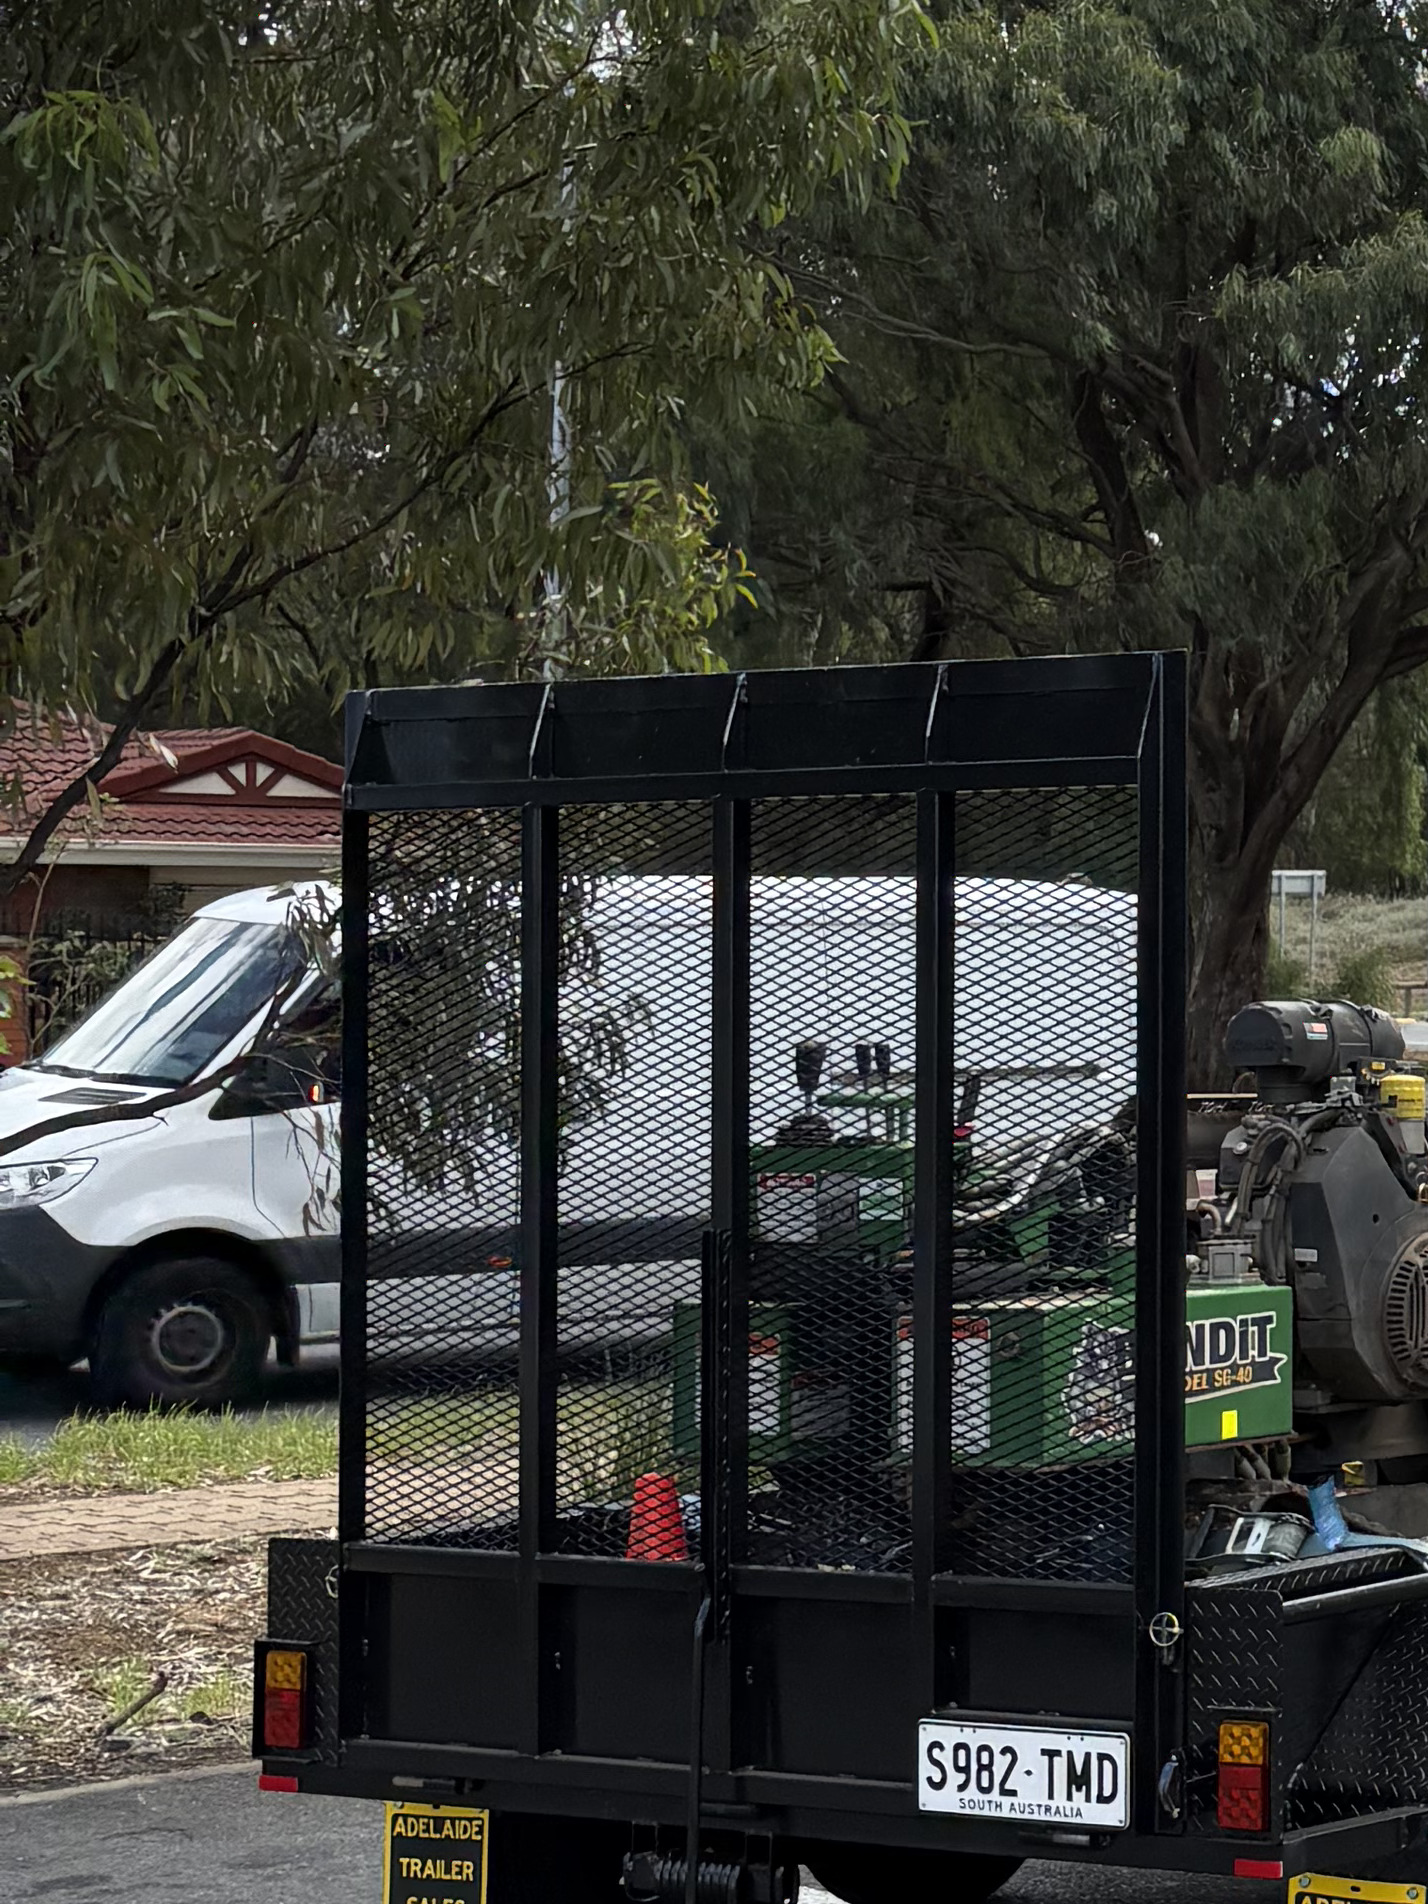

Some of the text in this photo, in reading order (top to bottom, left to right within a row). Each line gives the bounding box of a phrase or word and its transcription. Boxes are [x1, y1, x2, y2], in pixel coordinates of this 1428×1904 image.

[1213, 1365, 1254, 1388] SG-40
[957, 1797, 1084, 1820] SOUTH AUSTRALIA
[393, 1815, 482, 1841] ADELAIDE
[399, 1857, 474, 1882] TRAILER
